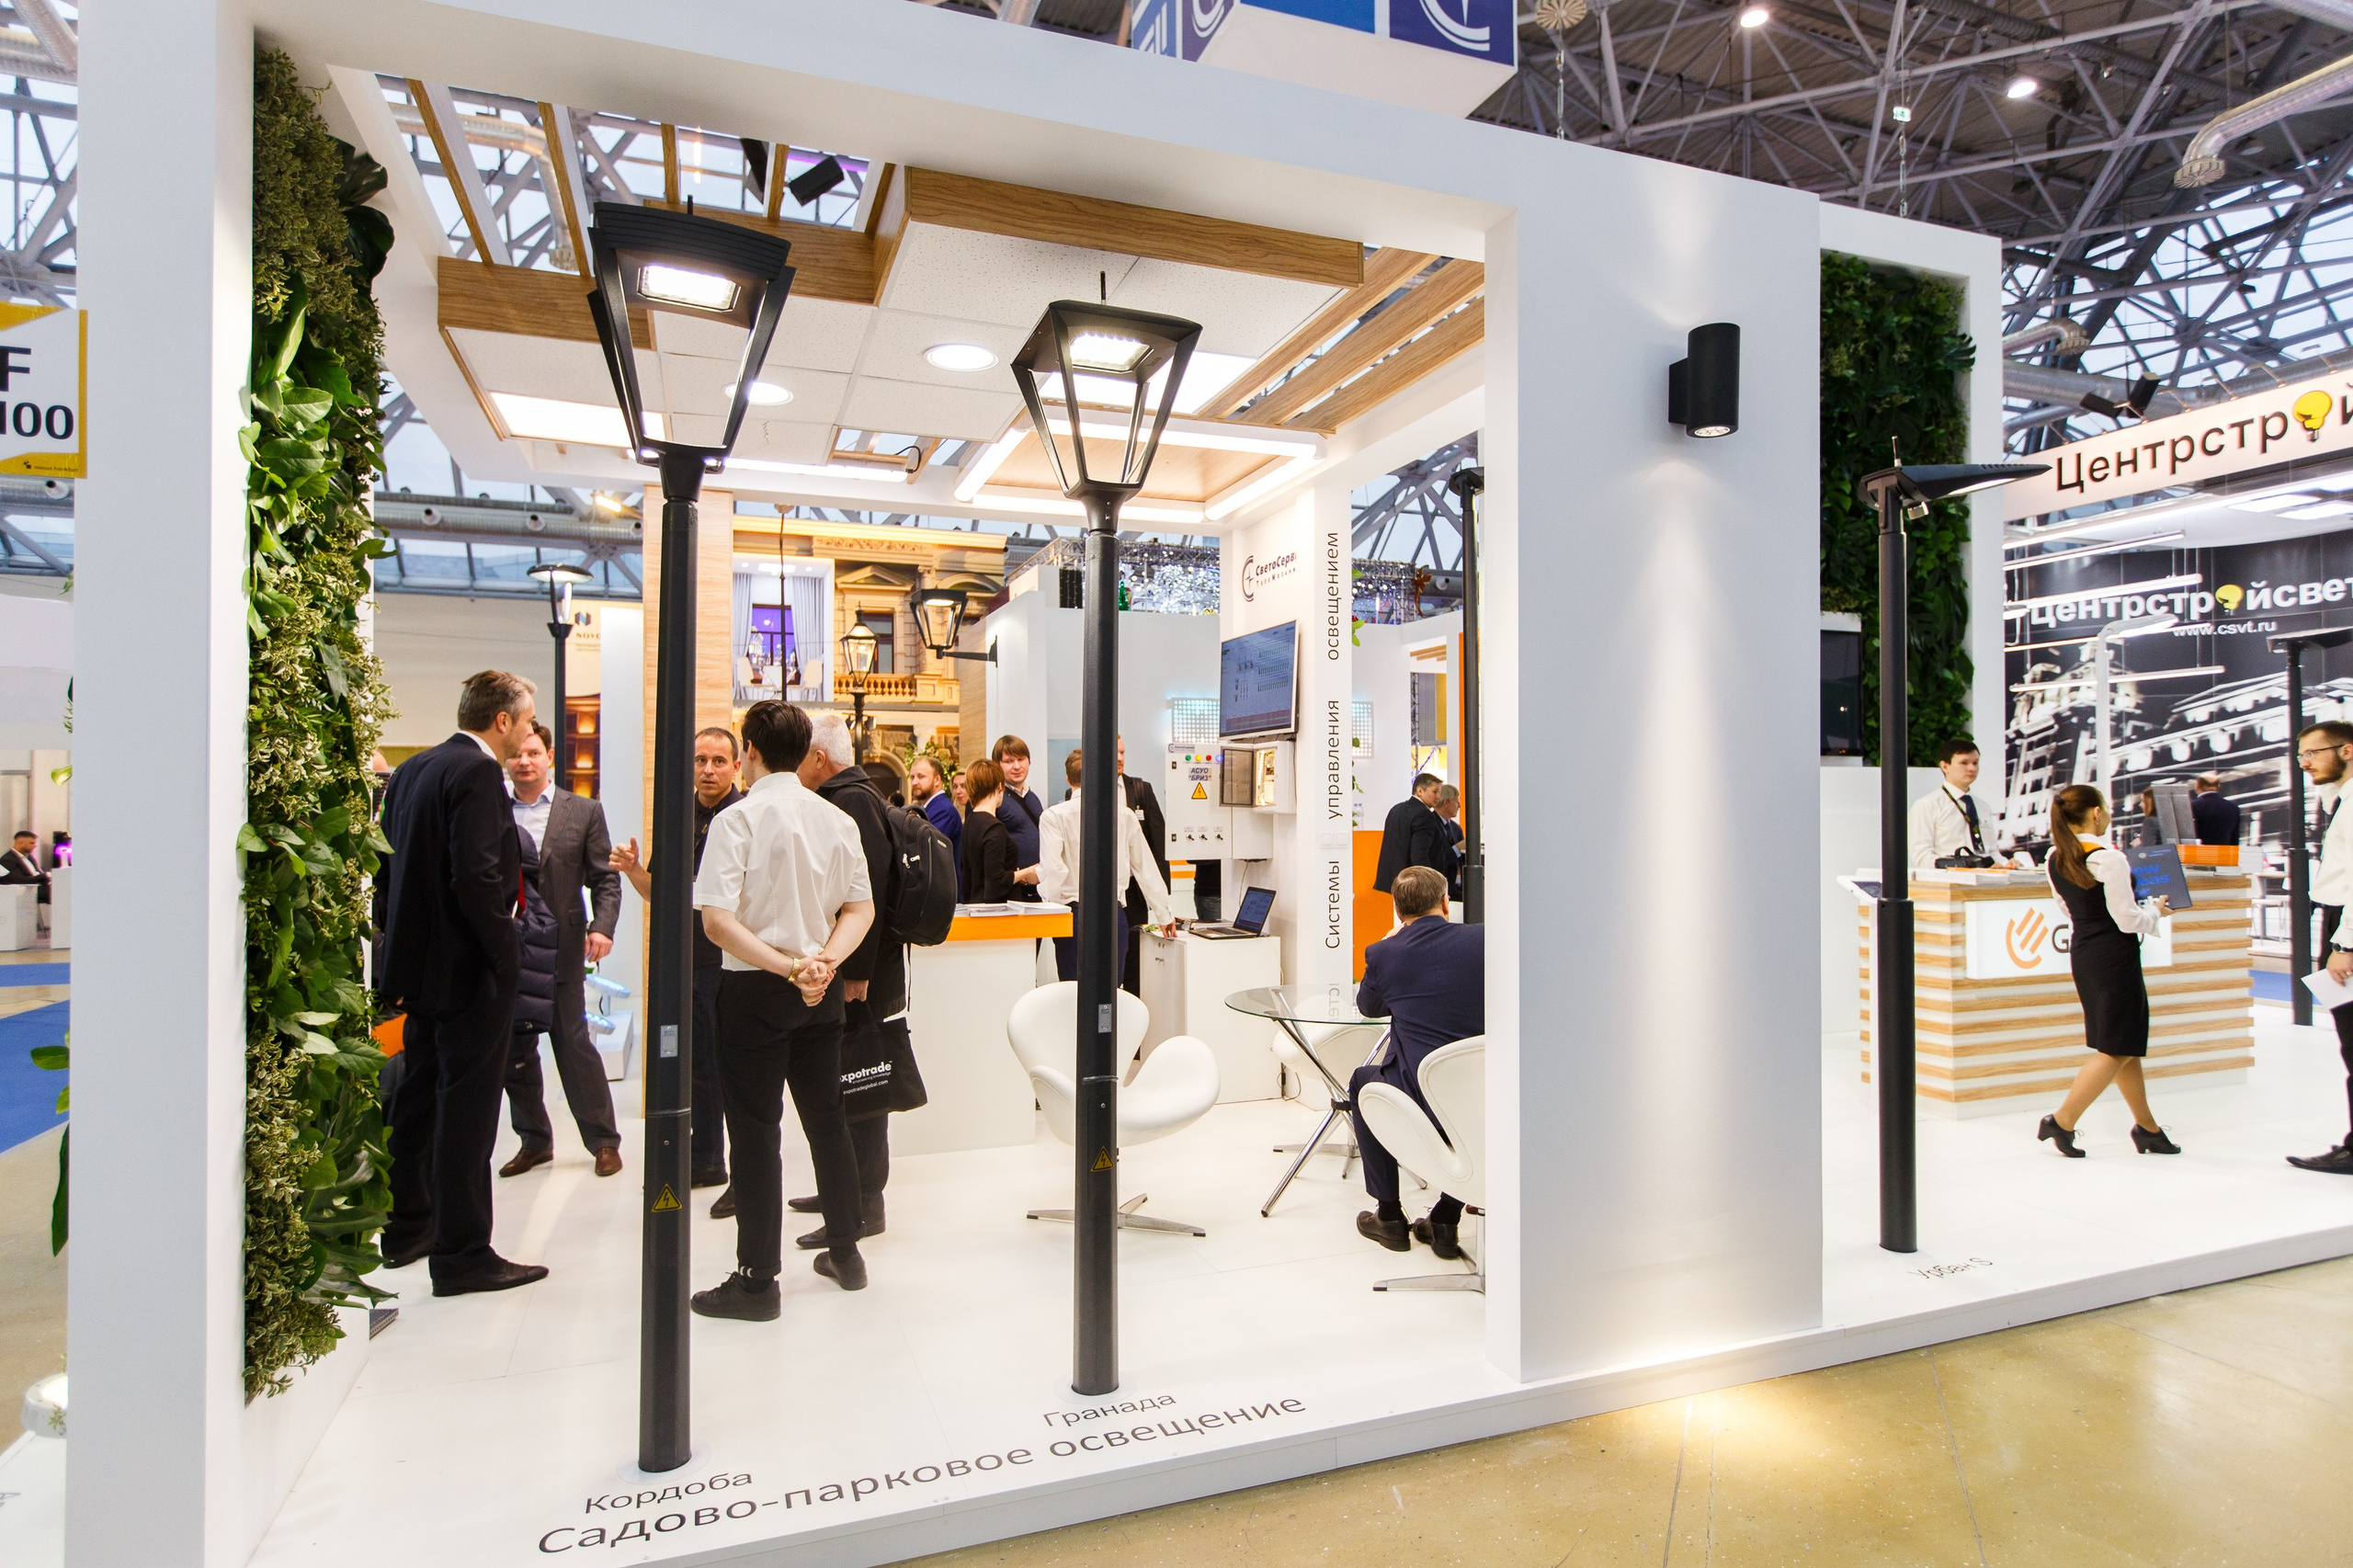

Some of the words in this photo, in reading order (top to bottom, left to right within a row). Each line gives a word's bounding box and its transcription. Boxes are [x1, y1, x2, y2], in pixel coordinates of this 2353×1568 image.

[1327, 532, 1342, 661] освещением
[2173, 620, 2278, 637] www.csvt.ru
[1328, 700, 1343, 820] управления
[1325, 860, 1340, 949] Системы
[840, 1062, 892, 1084] xpotrade
[1907, 1263, 1977, 1278] Урбан
[1043, 1394, 1177, 1426] Гранада
[539, 1447, 1034, 1553] Садово-парковое
[1049, 1398, 1307, 1456] освещение
[585, 1472, 753, 1514] Кордоба
